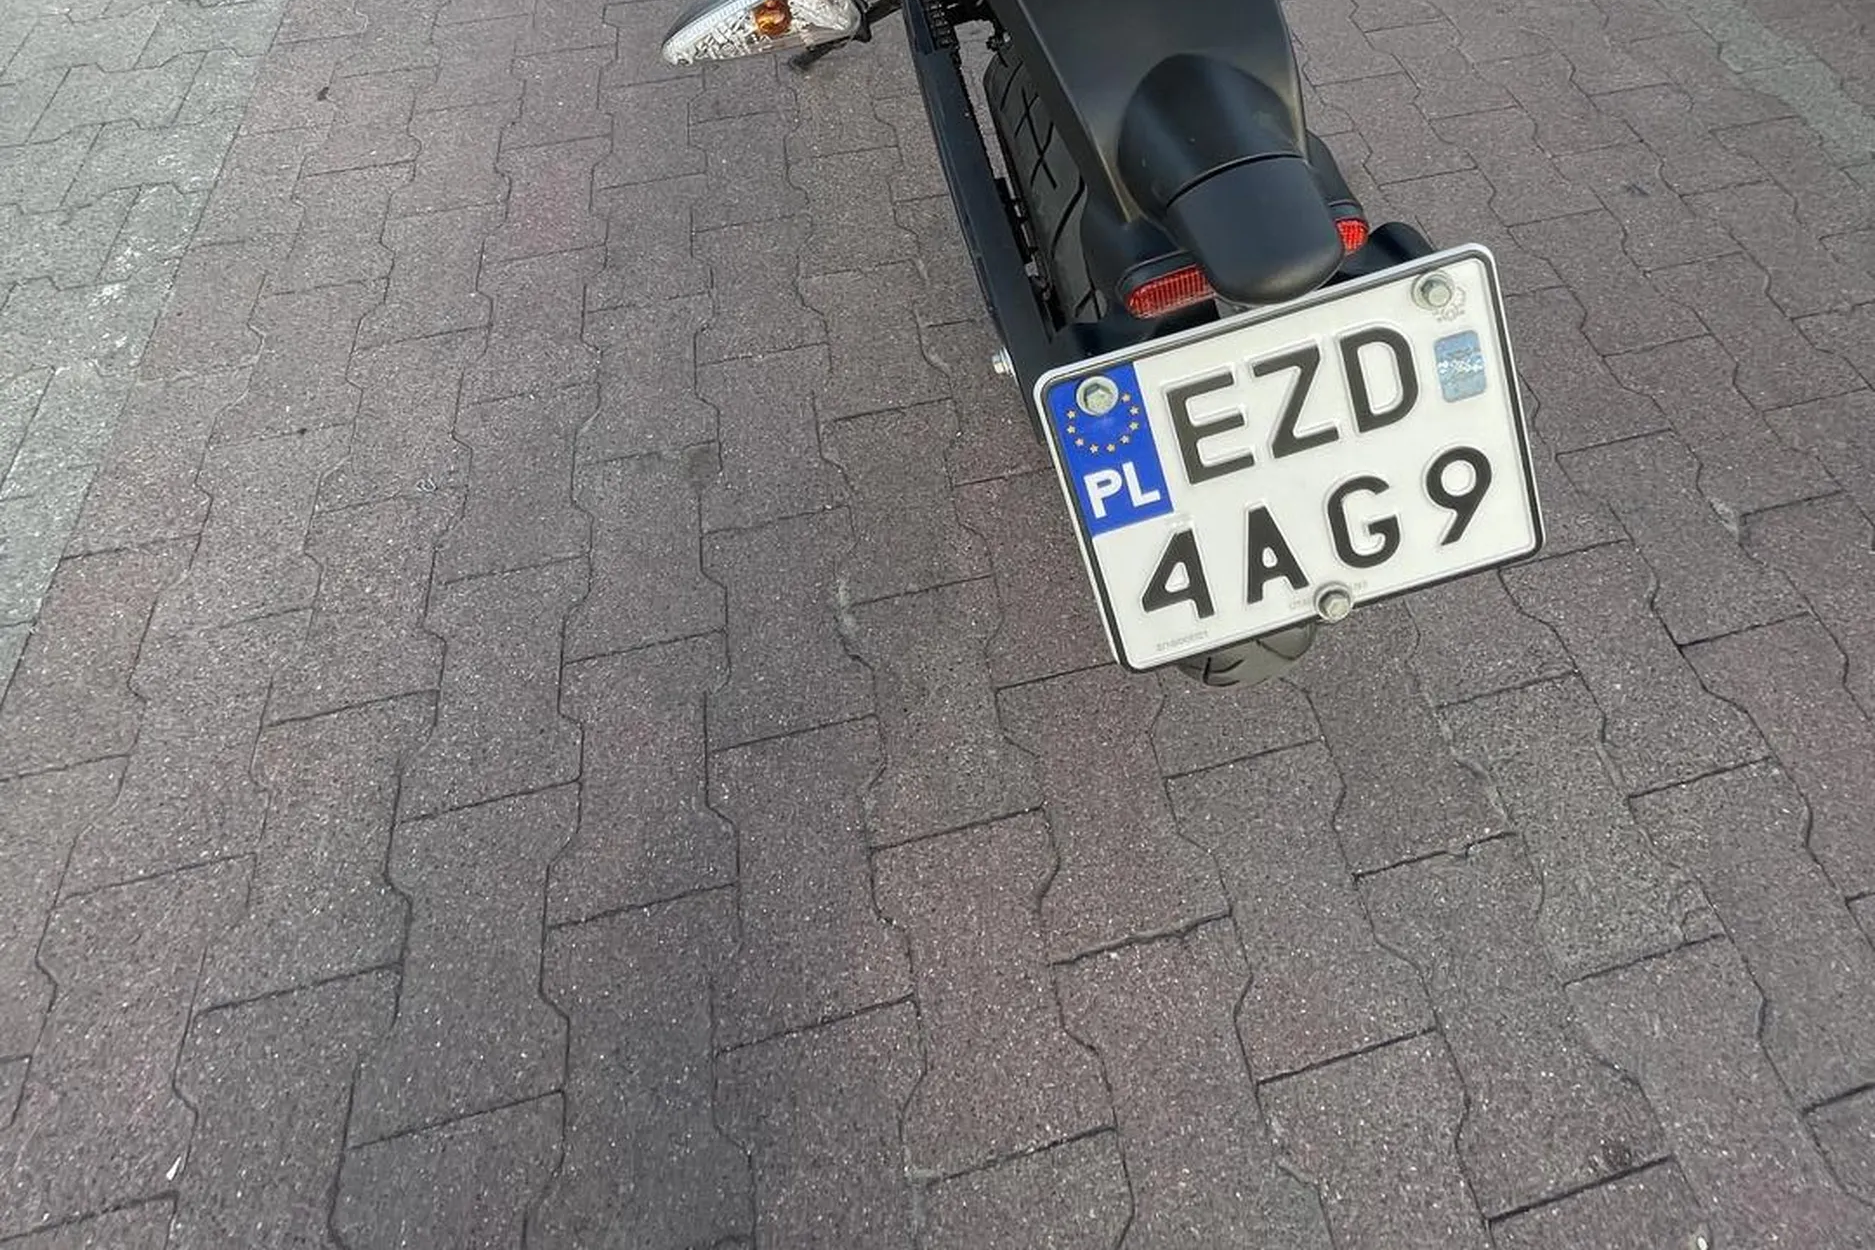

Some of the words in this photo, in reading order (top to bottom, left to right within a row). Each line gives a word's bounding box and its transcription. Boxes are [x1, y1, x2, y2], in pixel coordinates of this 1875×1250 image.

[1165, 325, 1419, 486] EZD
[1083, 461, 1161, 519] PL
[1140, 445, 1493, 619] 4AG9
